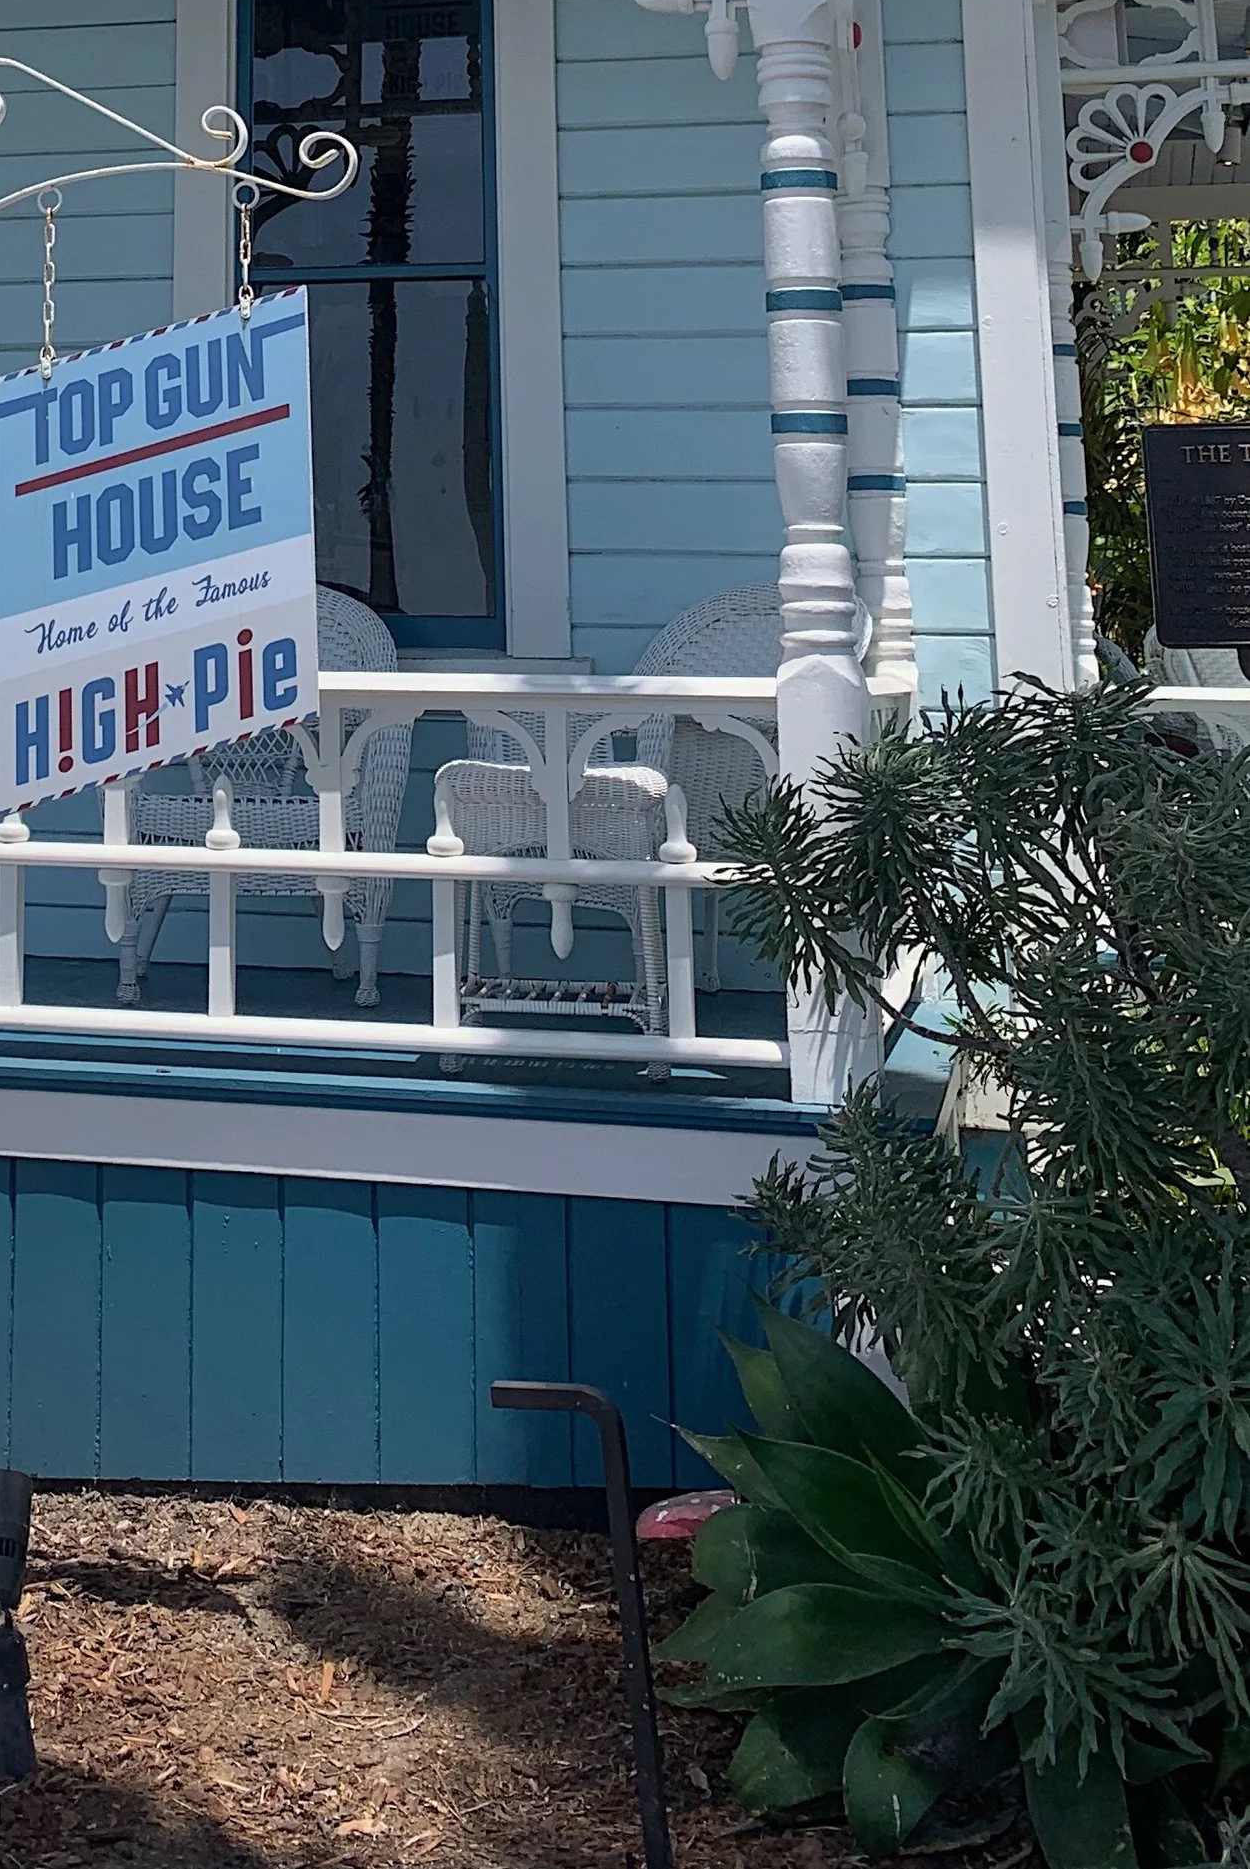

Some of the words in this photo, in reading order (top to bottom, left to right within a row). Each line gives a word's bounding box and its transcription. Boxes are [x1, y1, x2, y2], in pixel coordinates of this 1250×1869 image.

[145, 312, 306, 430] GUN
[1180, 444, 1232, 464] THE
[52, 443, 263, 579] HOUSE
[24, 618, 99, 655] Home
[108, 599, 134, 633] of
[142, 586, 179, 622] the
[192, 570, 272, 608] Famous
